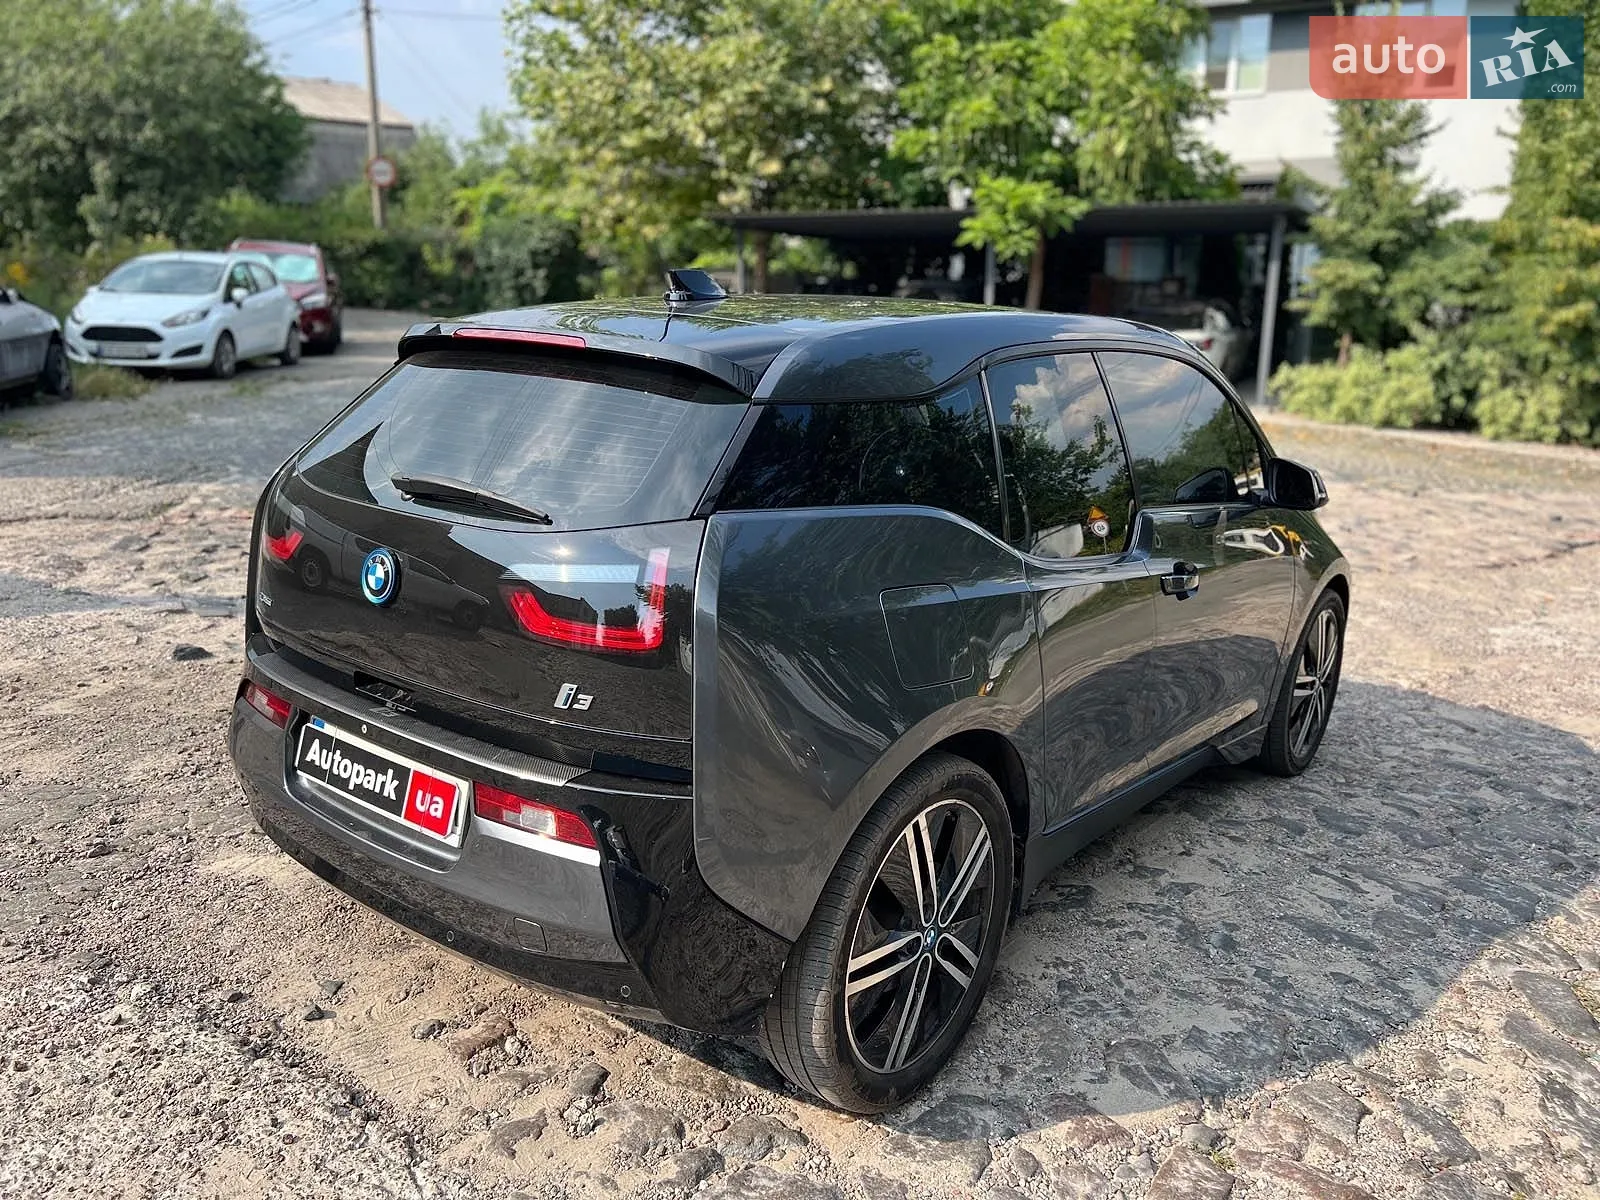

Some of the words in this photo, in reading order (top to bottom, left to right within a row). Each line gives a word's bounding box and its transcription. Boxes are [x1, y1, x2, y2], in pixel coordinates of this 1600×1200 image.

[553, 682, 594, 710] i3
[305, 738, 400, 801] Autopark
[415, 789, 444, 819] ua
